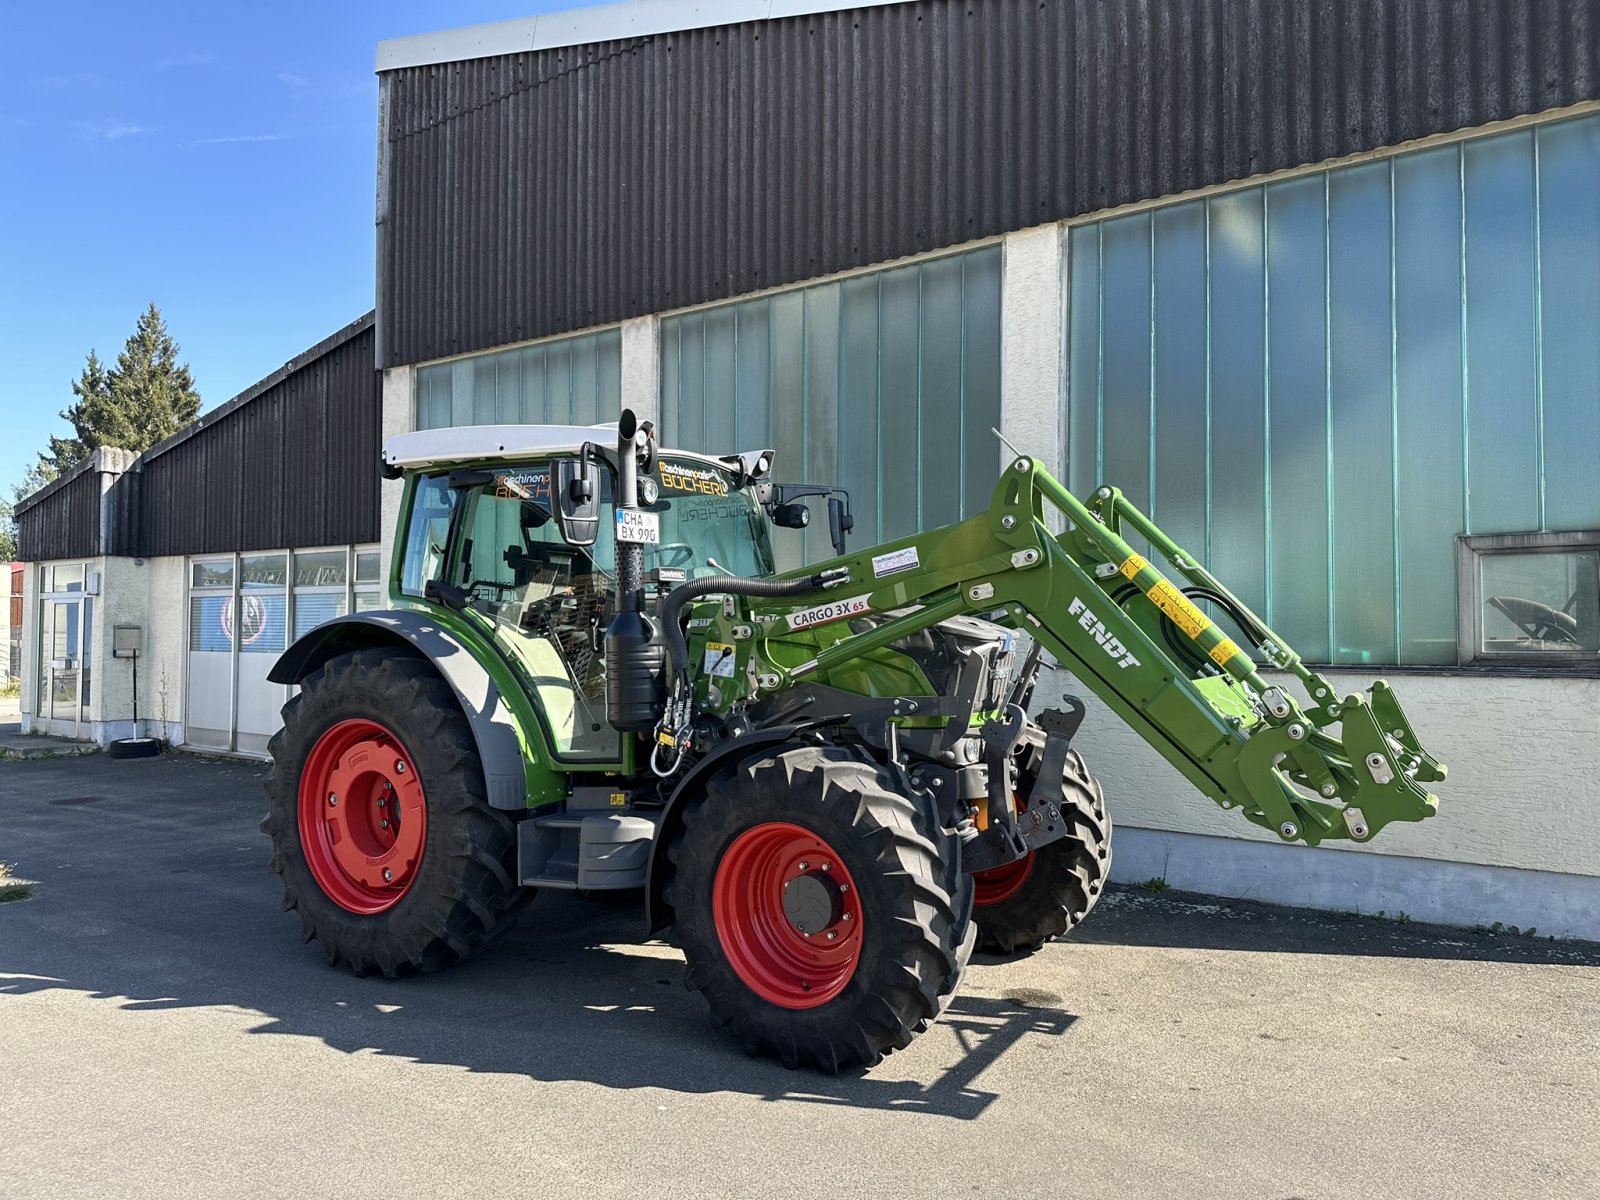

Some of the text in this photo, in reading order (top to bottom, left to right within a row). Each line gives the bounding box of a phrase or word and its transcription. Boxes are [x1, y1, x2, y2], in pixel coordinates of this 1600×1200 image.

[624, 512, 643, 526] CHA
[622, 526, 634, 540] BX
[793, 607, 833, 626] CARGO
[836, 602, 851, 616] 3X
[853, 601, 864, 611] 65
[1067, 596, 1141, 669] FENDT
